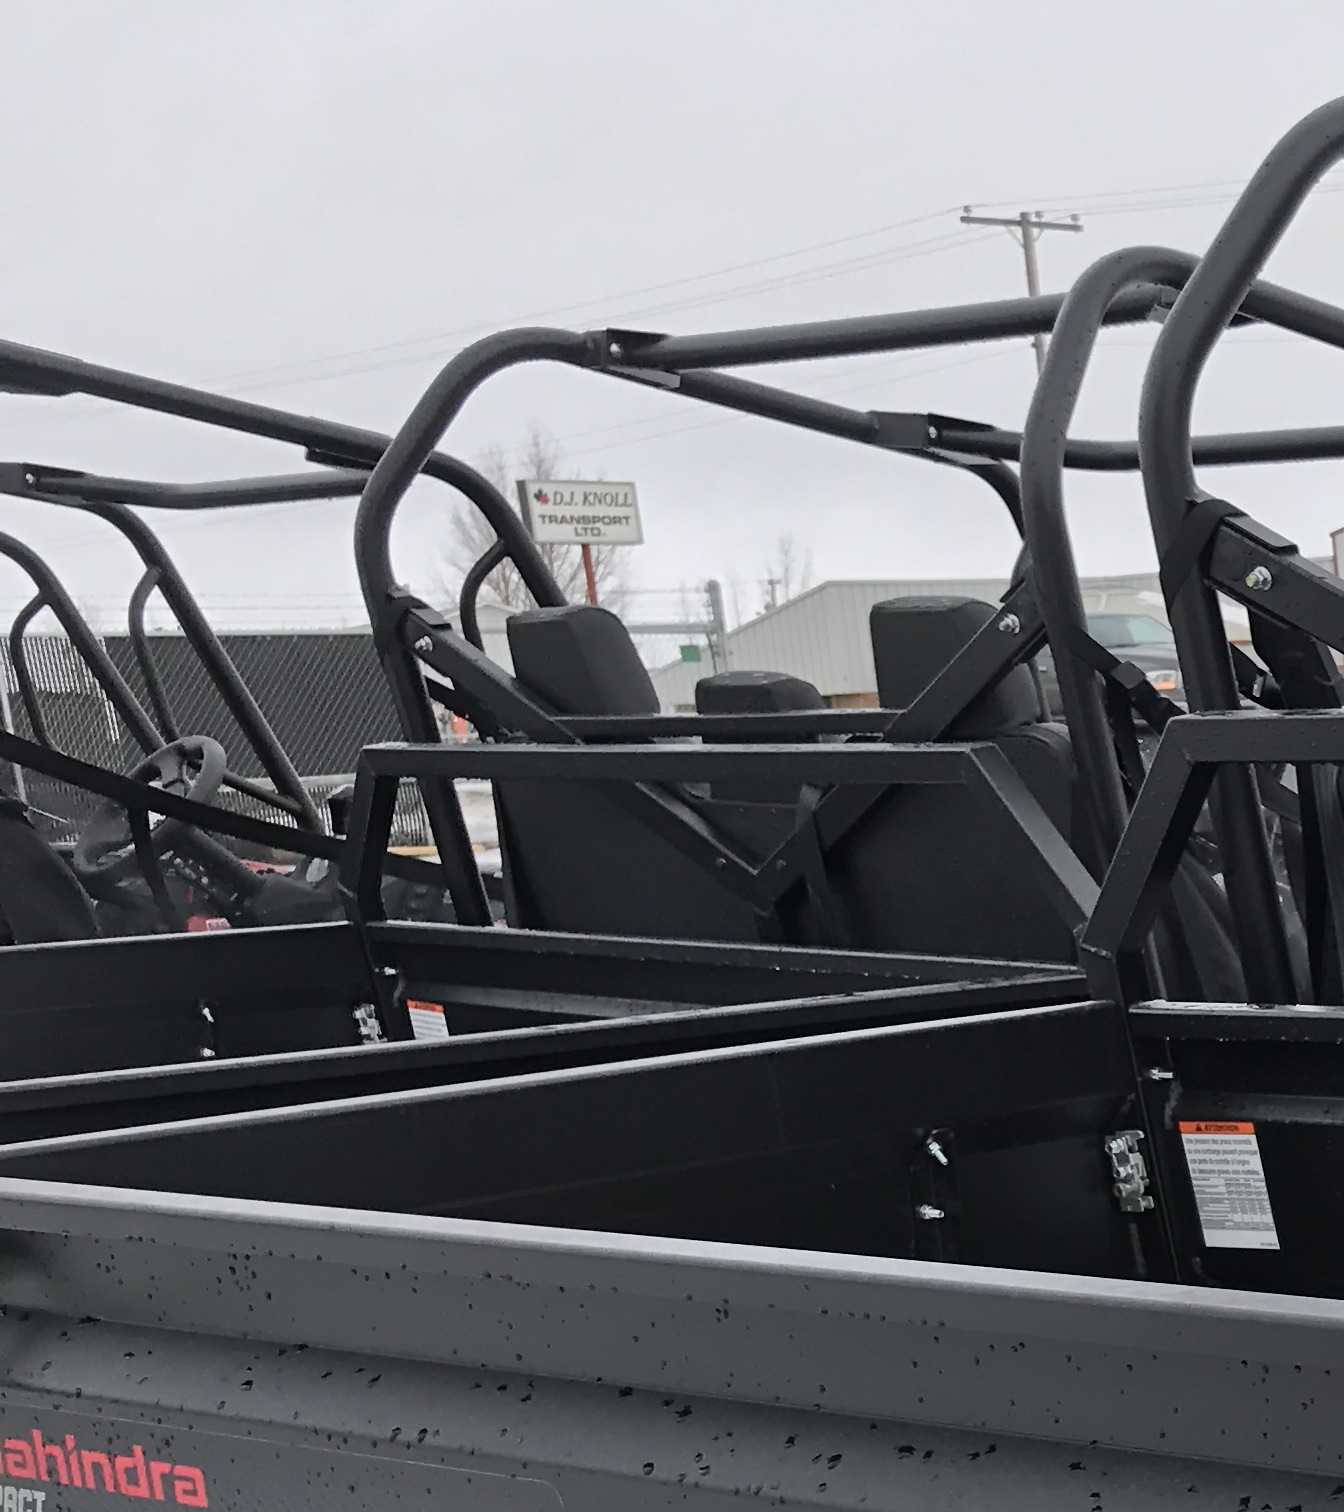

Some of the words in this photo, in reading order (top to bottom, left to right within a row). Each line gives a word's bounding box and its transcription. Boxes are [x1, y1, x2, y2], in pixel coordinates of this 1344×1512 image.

[552, 491, 578, 507] D.J.
[582, 491, 633, 508] KNOLL
[539, 514, 631, 526] TRANSPORT
[0, 1429, 208, 1508] ahindra
